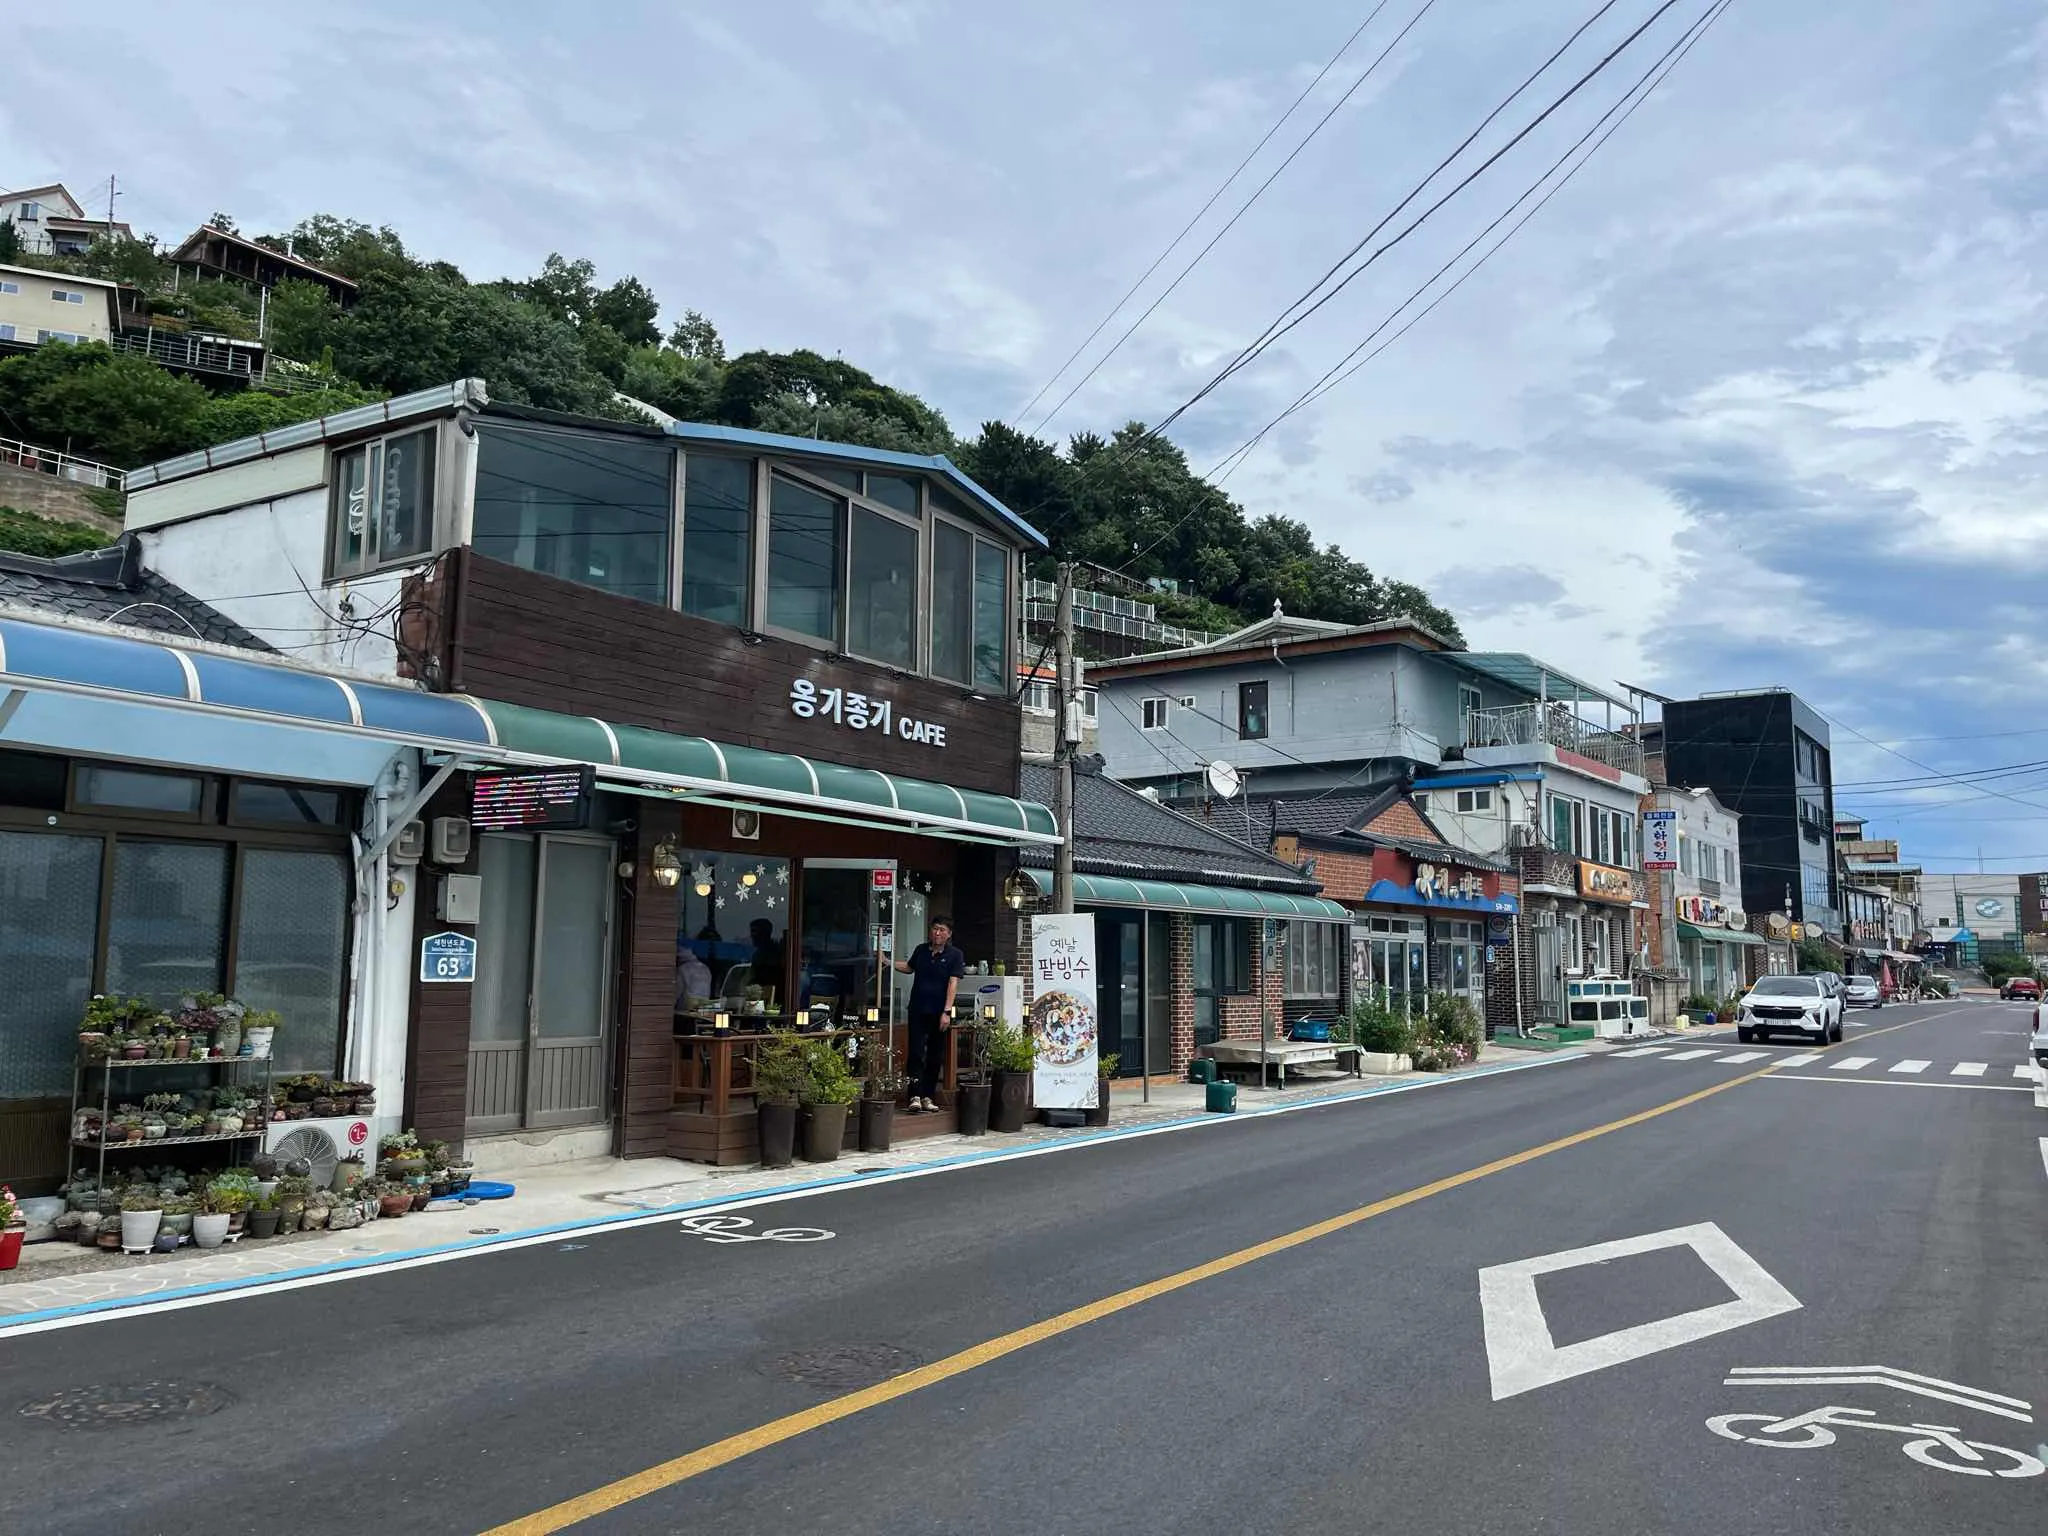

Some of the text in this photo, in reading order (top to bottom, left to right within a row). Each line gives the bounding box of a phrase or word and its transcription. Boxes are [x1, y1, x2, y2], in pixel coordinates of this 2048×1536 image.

[790, 679, 946, 747] 옹기종기 CAFE
[1049, 936, 1079, 954] 옛날
[437, 957, 459, 976] 63
[1038, 956, 1091, 981] 팥빙수
